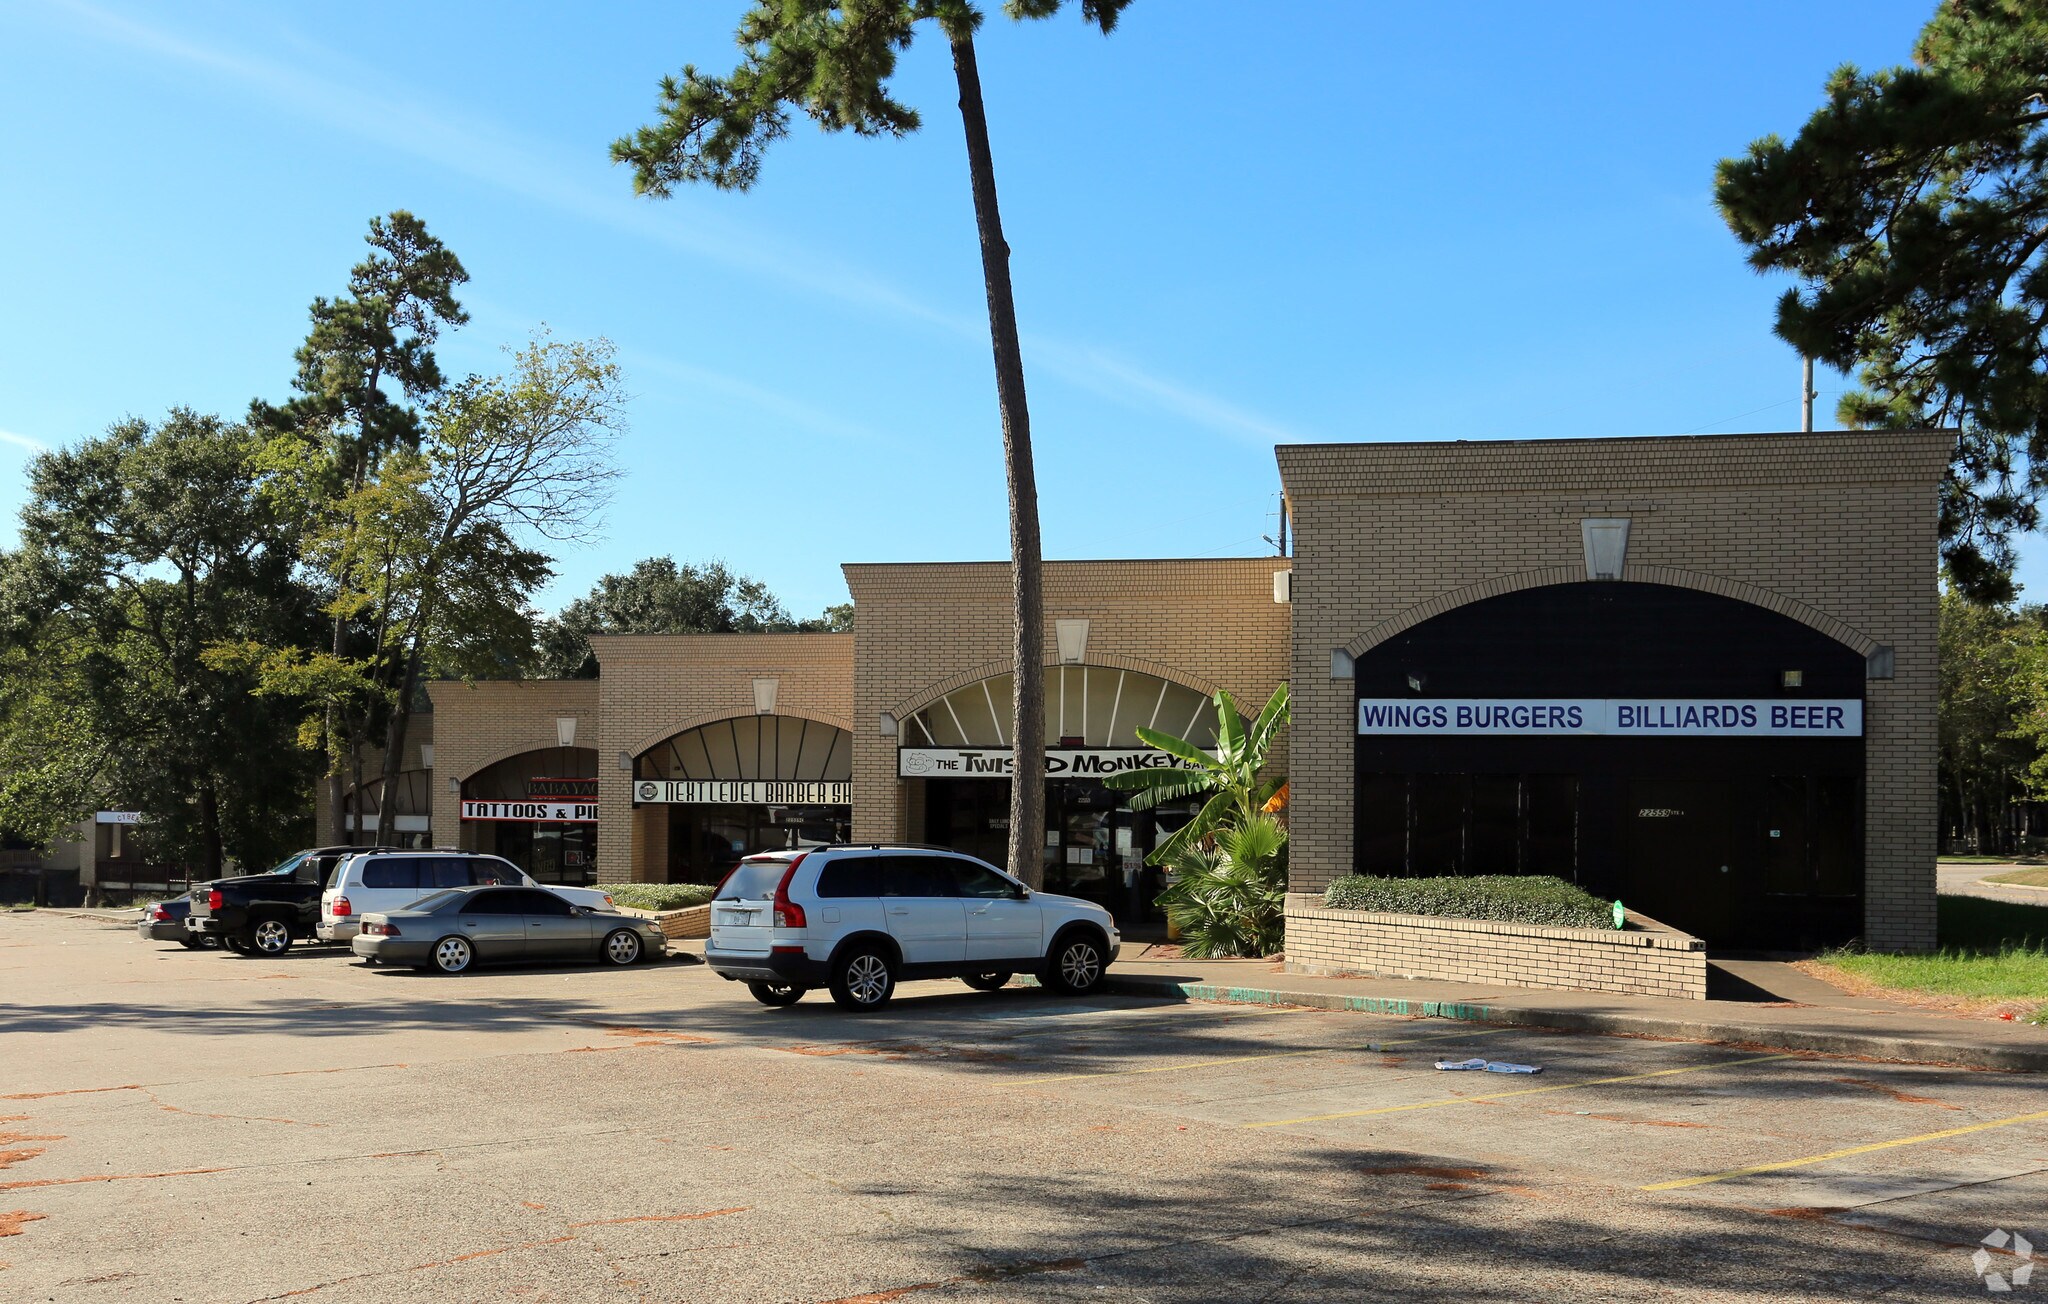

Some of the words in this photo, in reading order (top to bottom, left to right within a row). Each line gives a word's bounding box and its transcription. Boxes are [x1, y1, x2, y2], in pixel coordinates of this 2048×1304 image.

[1363, 705, 1448, 728] WINGS
[1456, 705, 1583, 728] BURGERS
[1618, 705, 1757, 728] BILLIARDS
[1771, 706, 1845, 729] BEER
[936, 759, 959, 770] THE
[1072, 753, 1184, 773] MONKEY
[665, 781, 705, 802] NEXT
[709, 782, 760, 803] LEVEL
[765, 782, 826, 804] BARBER
[465, 802, 548, 818] TATTOOS
[555, 808, 568, 819] &
[1639, 809, 1671, 817] 22559
